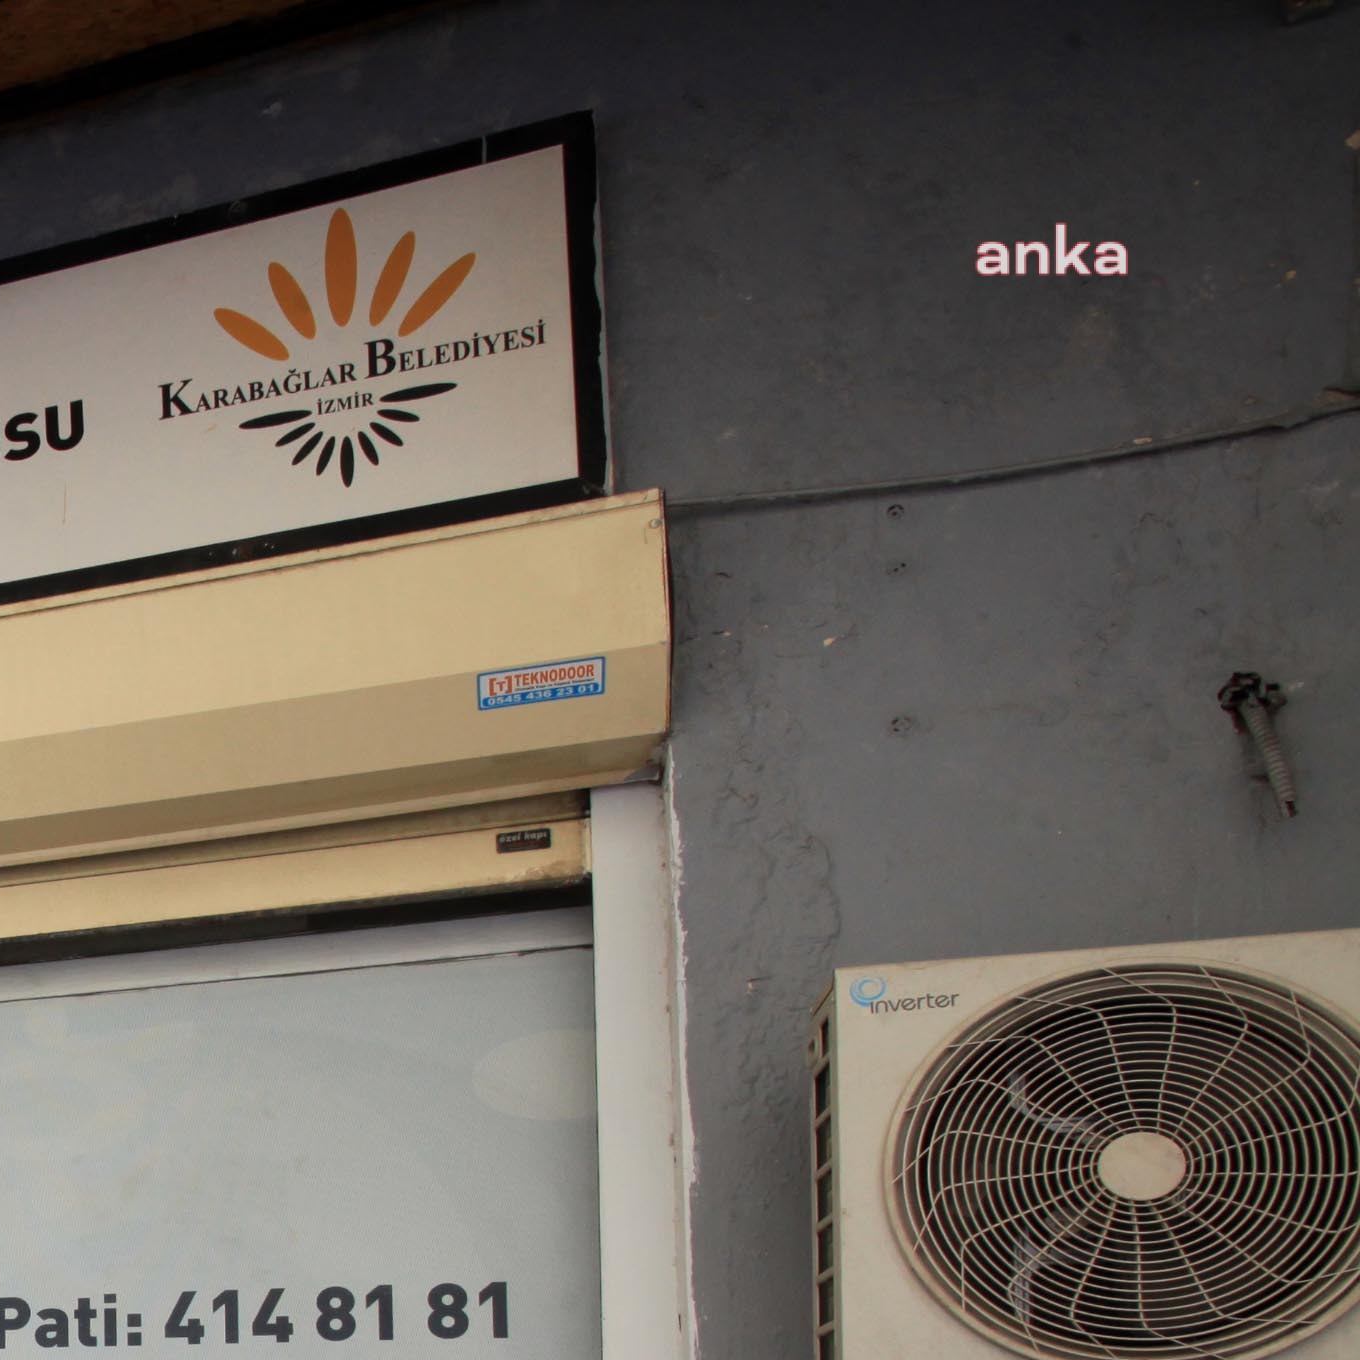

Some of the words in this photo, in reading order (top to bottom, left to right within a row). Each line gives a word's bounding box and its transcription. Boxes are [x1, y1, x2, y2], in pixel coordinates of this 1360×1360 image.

[158, 362, 357, 421] KARABAĞLAR
[364, 319, 547, 379] BELEDİYESİ
[316, 391, 374, 416] İZMİR
[514, 664, 595, 687] TEKNODOOR
[488, 694, 521, 706] 0545
[578, 683, 595, 693] 01
[870, 993, 960, 1014] inverter
[164, 1288, 294, 1344] 414
[316, 1284, 393, 1341] 81
[427, 1281, 509, 1340] 81
